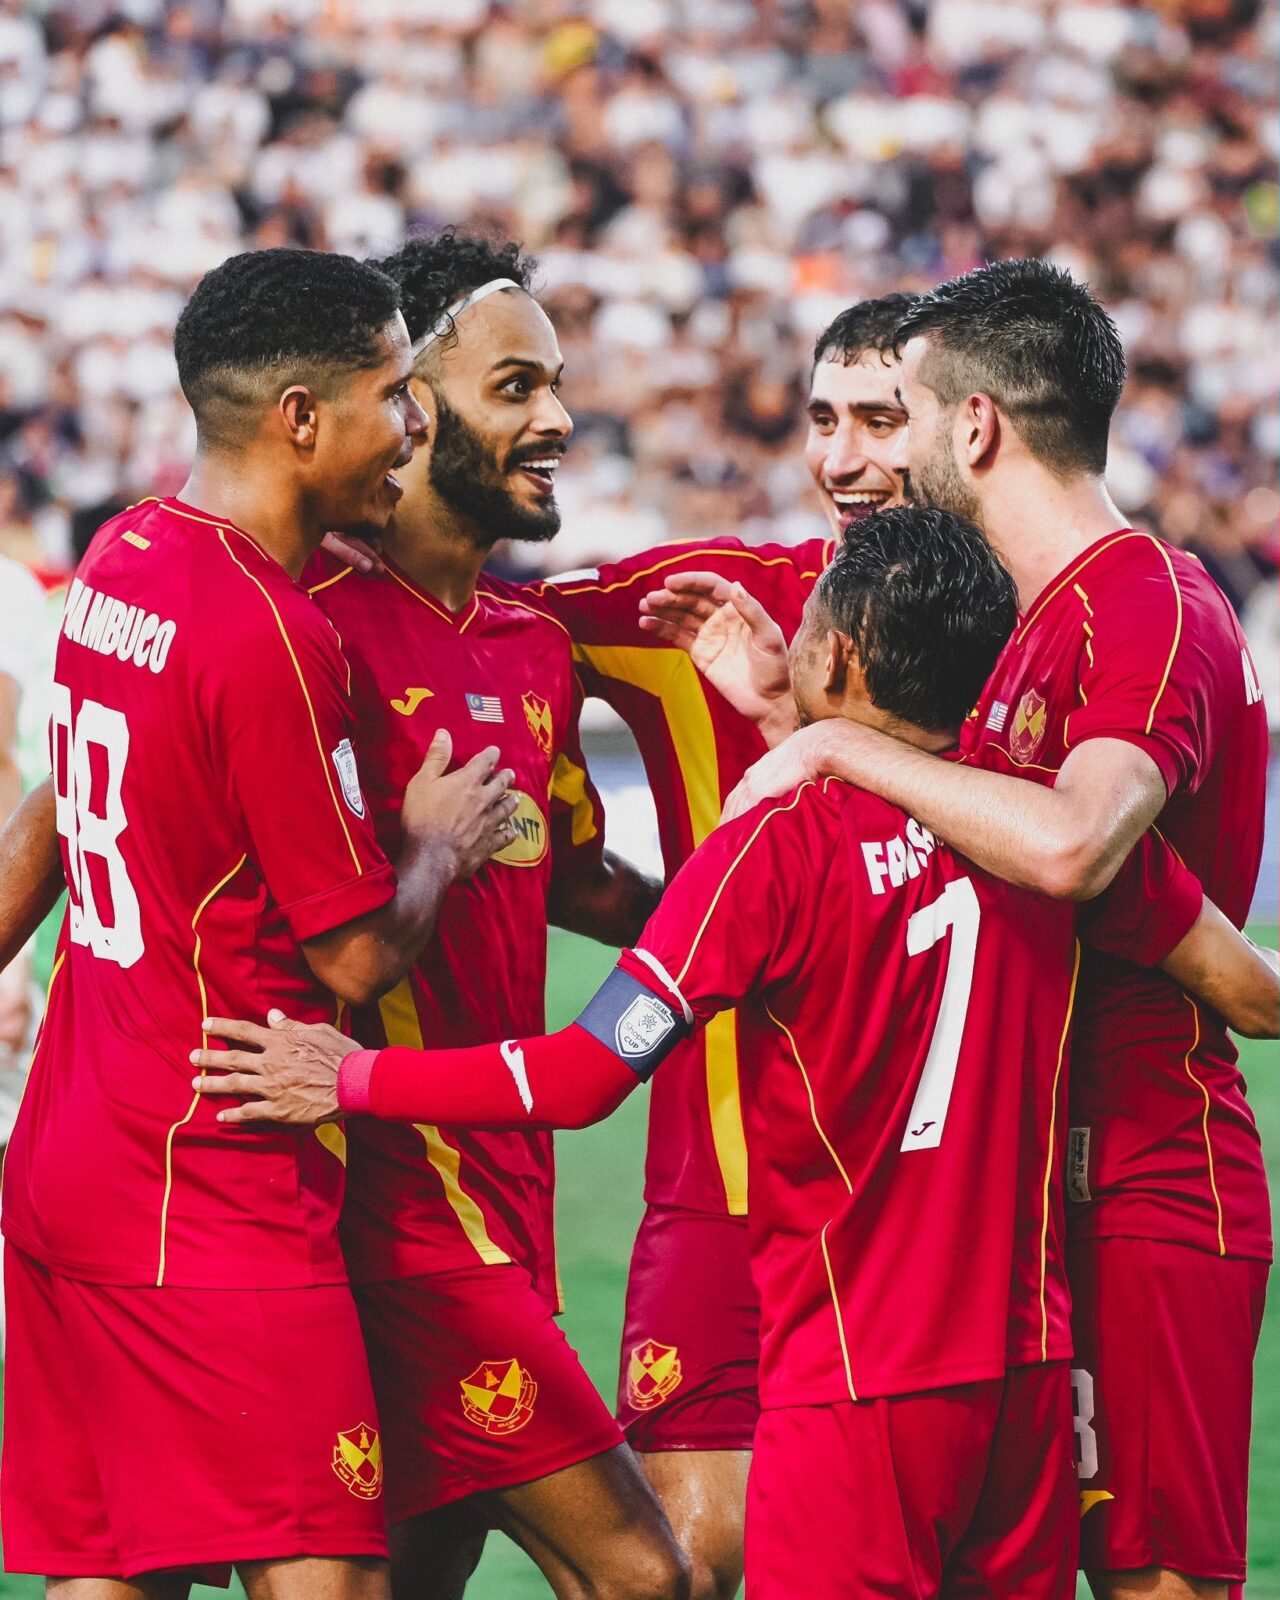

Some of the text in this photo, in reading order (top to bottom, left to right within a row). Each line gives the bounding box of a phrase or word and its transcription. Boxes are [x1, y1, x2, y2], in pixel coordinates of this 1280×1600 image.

[52, 681, 146, 969] 98
[623, 1021, 650, 1048] Shopee
[623, 1035, 639, 1049] CUP
[900, 875, 981, 1153] 7
